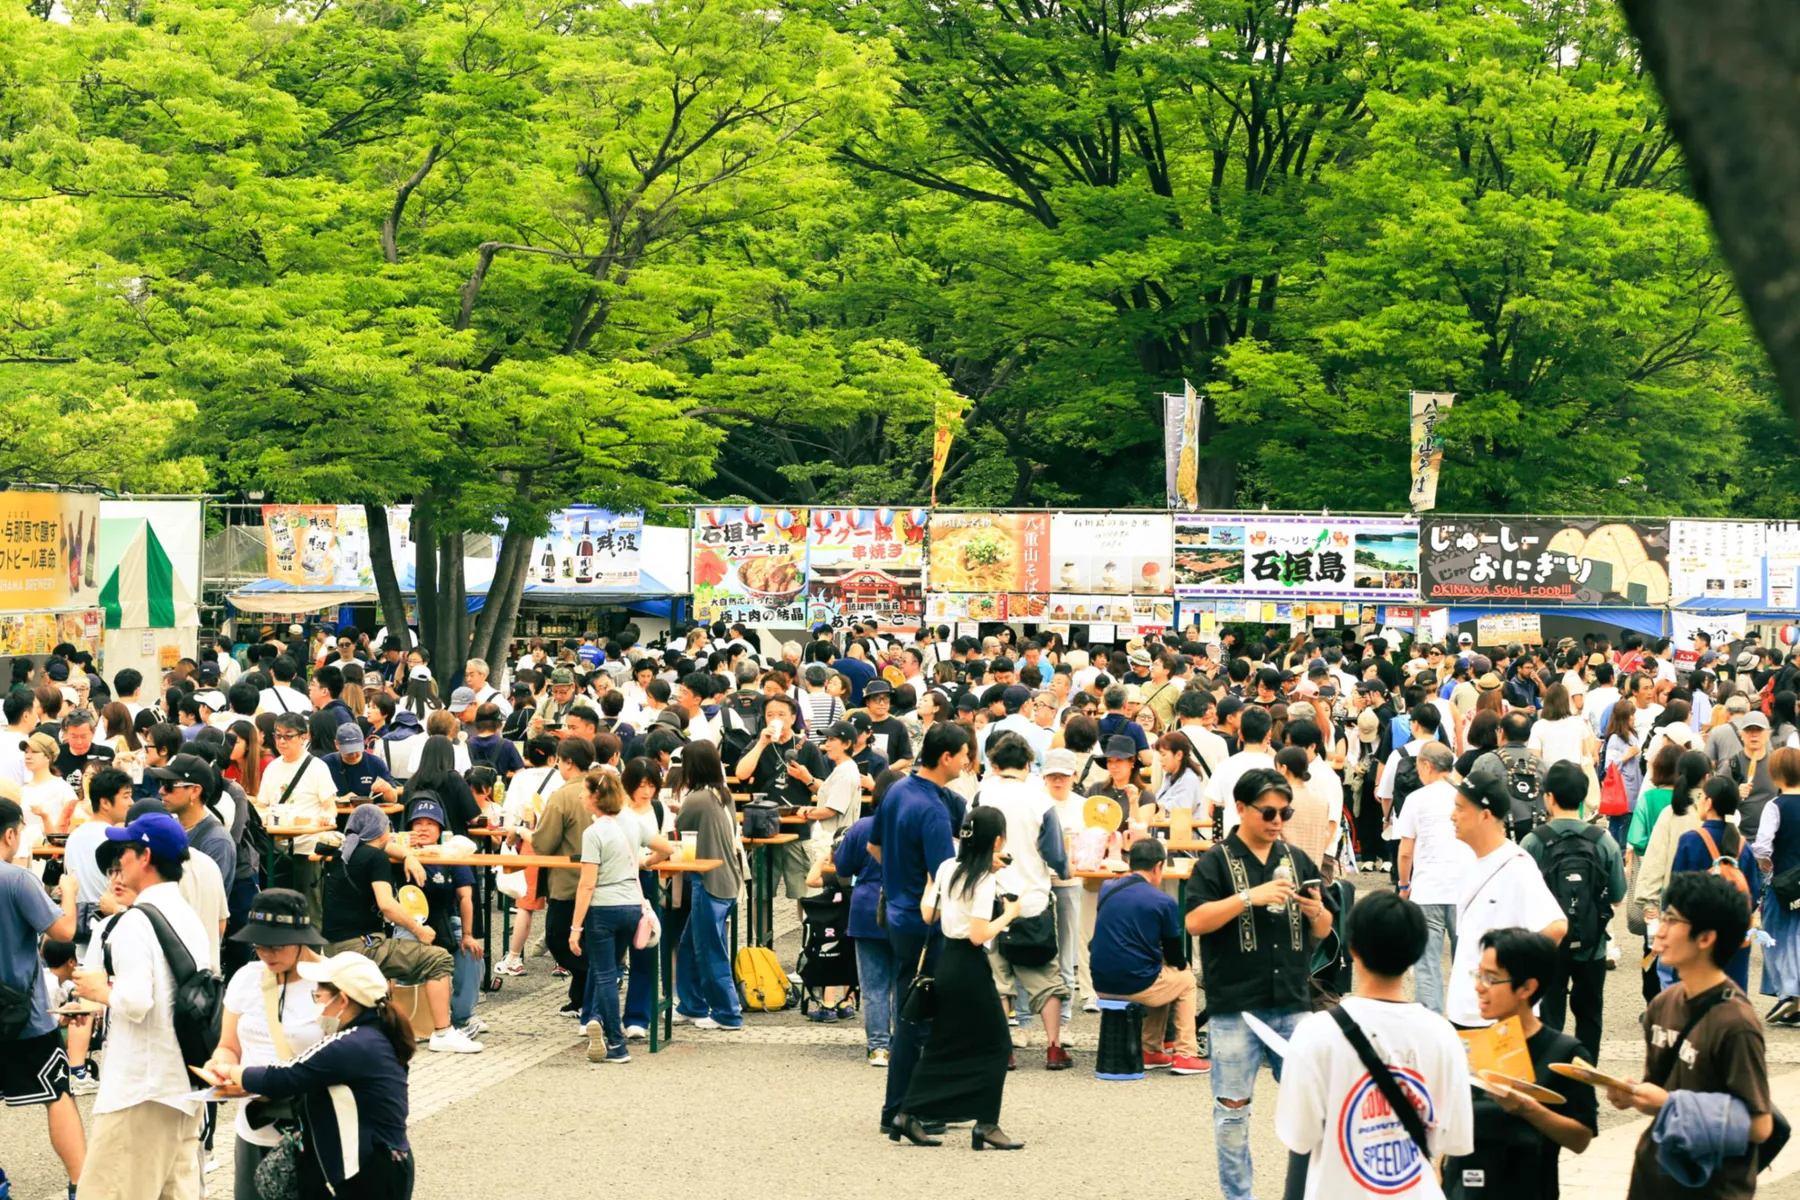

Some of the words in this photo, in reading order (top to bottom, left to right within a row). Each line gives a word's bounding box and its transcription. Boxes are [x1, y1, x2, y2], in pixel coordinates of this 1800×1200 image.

[702, 523, 766, 544] 石垣牛
[1431, 525, 1539, 552] じゅーしー
[727, 543, 790, 557] ステーキ丼
[852, 543, 904, 560] 串焼き
[1024, 519, 1039, 592] 八重山そば
[1251, 549, 1347, 583] 石垣島
[1469, 552, 1592, 584] おにぎり
[1432, 584, 1488, 596] OKINAWA
[1494, 585, 1526, 596] SOUL
[1530, 584, 1572, 597] FOOD!!!
[719, 607, 804, 624] 極上肉の結晶
[418, 802, 435, 811] GAP
[1363, 1139, 1419, 1177] SPEEDWA
